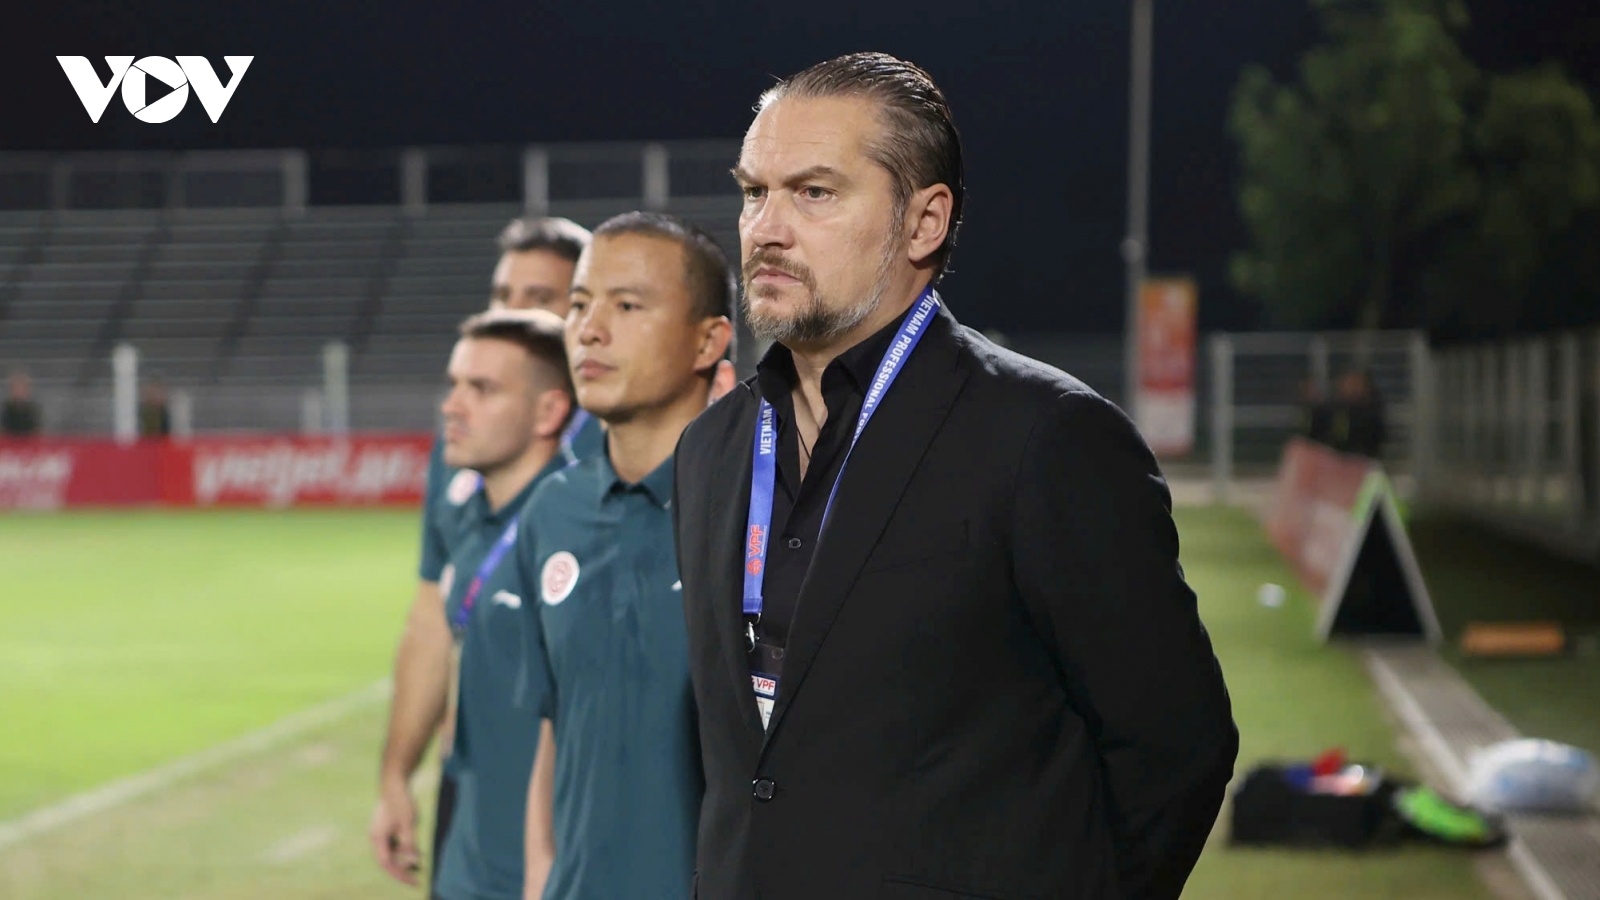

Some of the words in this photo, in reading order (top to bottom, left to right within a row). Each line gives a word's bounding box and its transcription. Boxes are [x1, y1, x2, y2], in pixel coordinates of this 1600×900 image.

[905, 294, 935, 336] VIETNAM
[864, 333, 912, 410] PROFESSIONAL
[760, 407, 773, 455] VIETNAM
[748, 524, 763, 558] VPF
[756, 677, 775, 690] VPF
